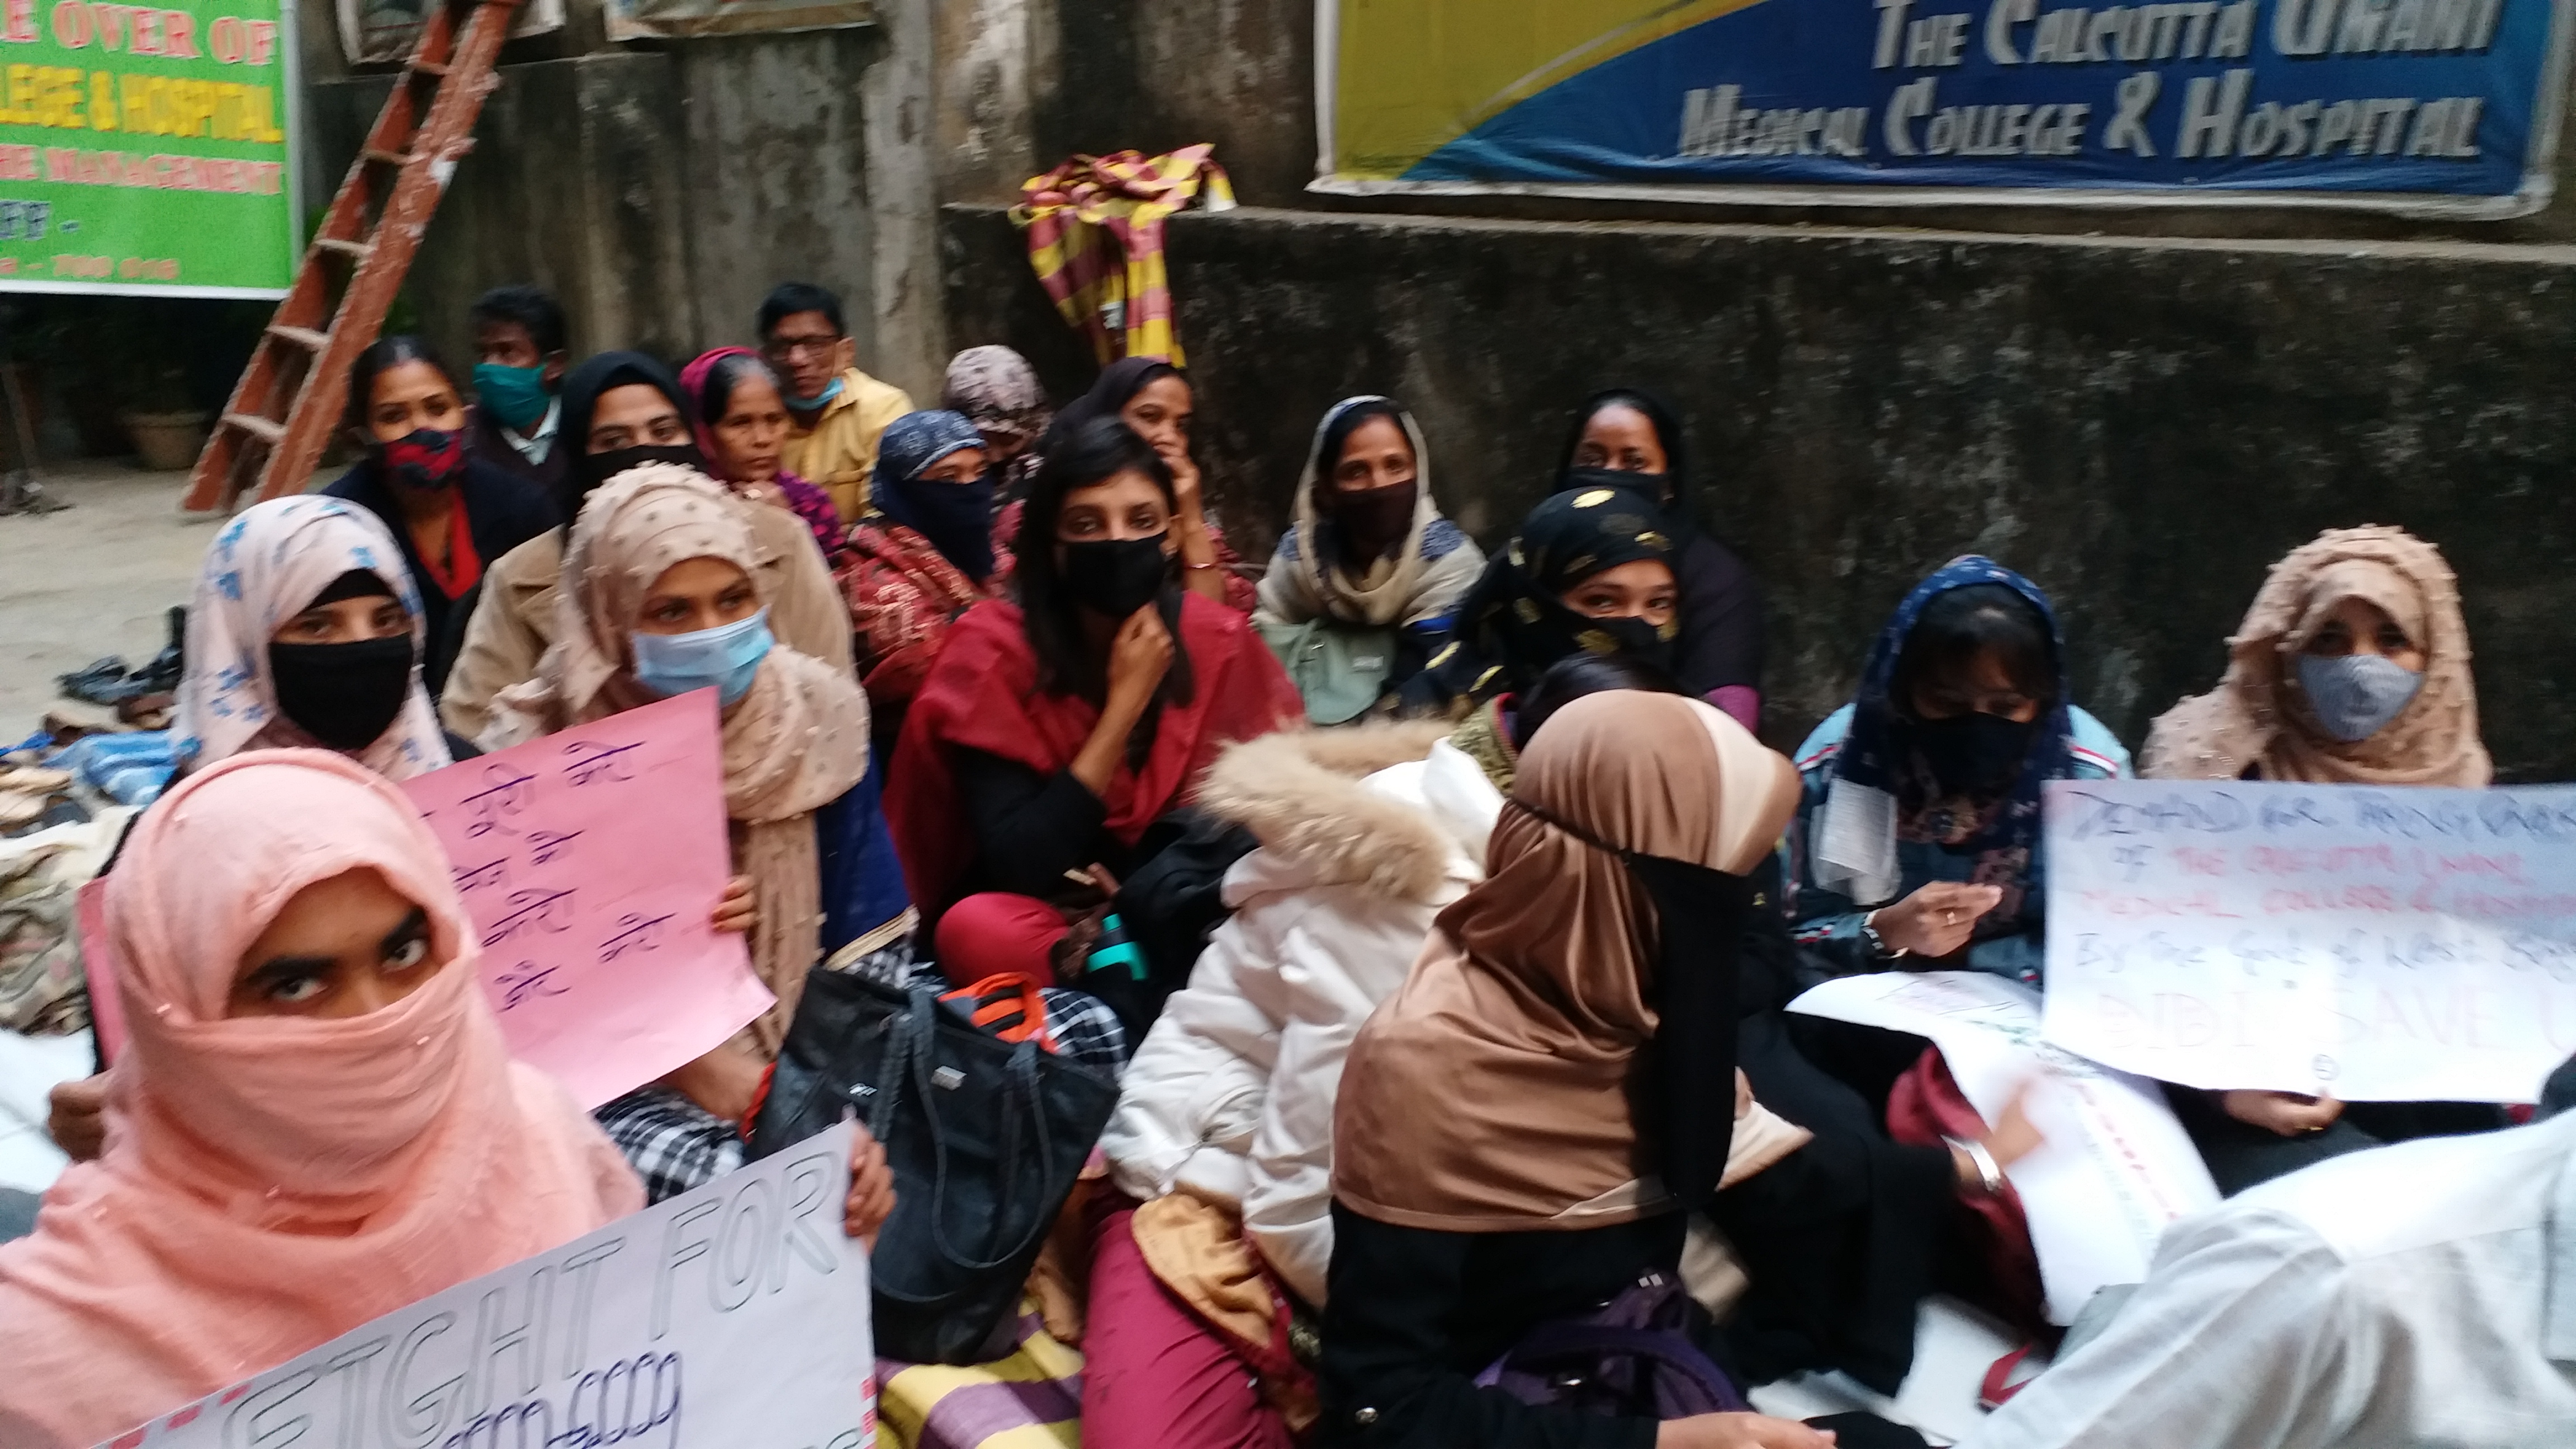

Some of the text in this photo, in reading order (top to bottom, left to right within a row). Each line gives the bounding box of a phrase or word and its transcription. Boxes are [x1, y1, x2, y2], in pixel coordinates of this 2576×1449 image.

[52, 0, 202, 59] OVER
[209, 16, 278, 65] OF
[1872, 0, 1973, 69] THE
[1983, 0, 2256, 65] CALCUTTA
[119, 73, 285, 143] HOSPITAL
[1680, 68, 2487, 158] MEDICAL COLLEGE & HOSPITAL
[44, 146, 282, 196] MANAGEMENT
[648, 1150, 840, 1342] FOR
